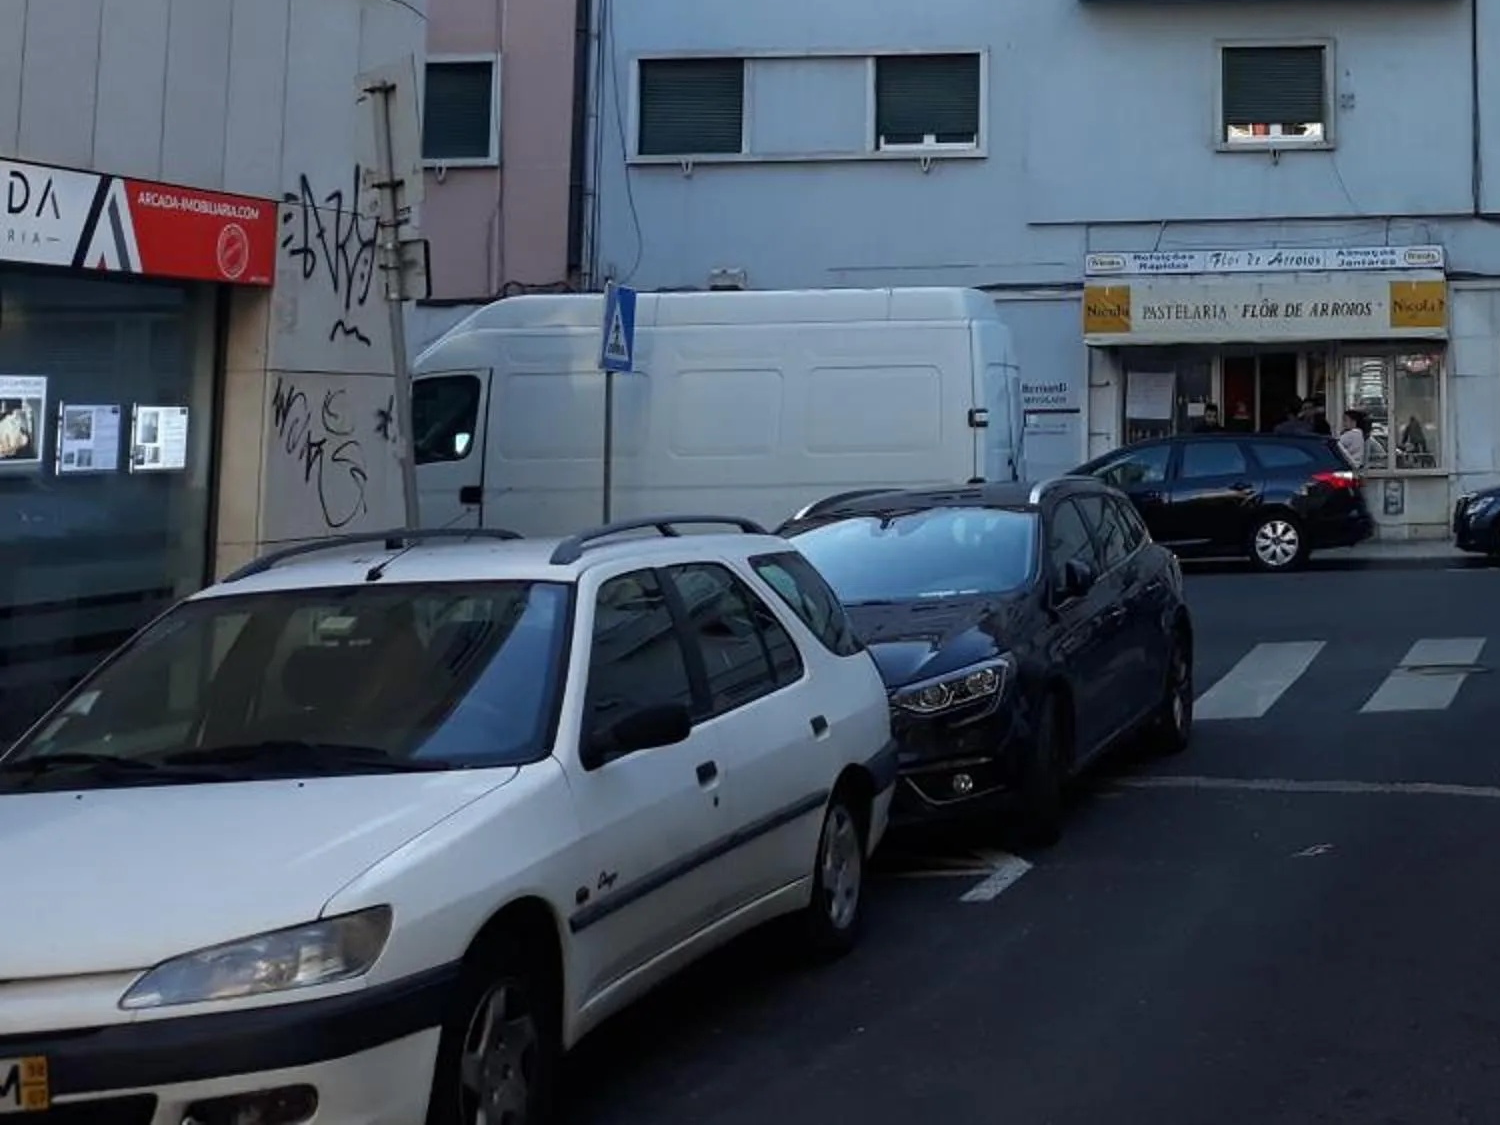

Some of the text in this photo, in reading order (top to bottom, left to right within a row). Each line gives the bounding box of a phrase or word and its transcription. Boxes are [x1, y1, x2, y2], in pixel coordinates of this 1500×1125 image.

[1142, 303, 1227, 321] PASTELARIA
[1284, 302, 1304, 318] DE
[1310, 301, 1373, 318] ARROIOS
